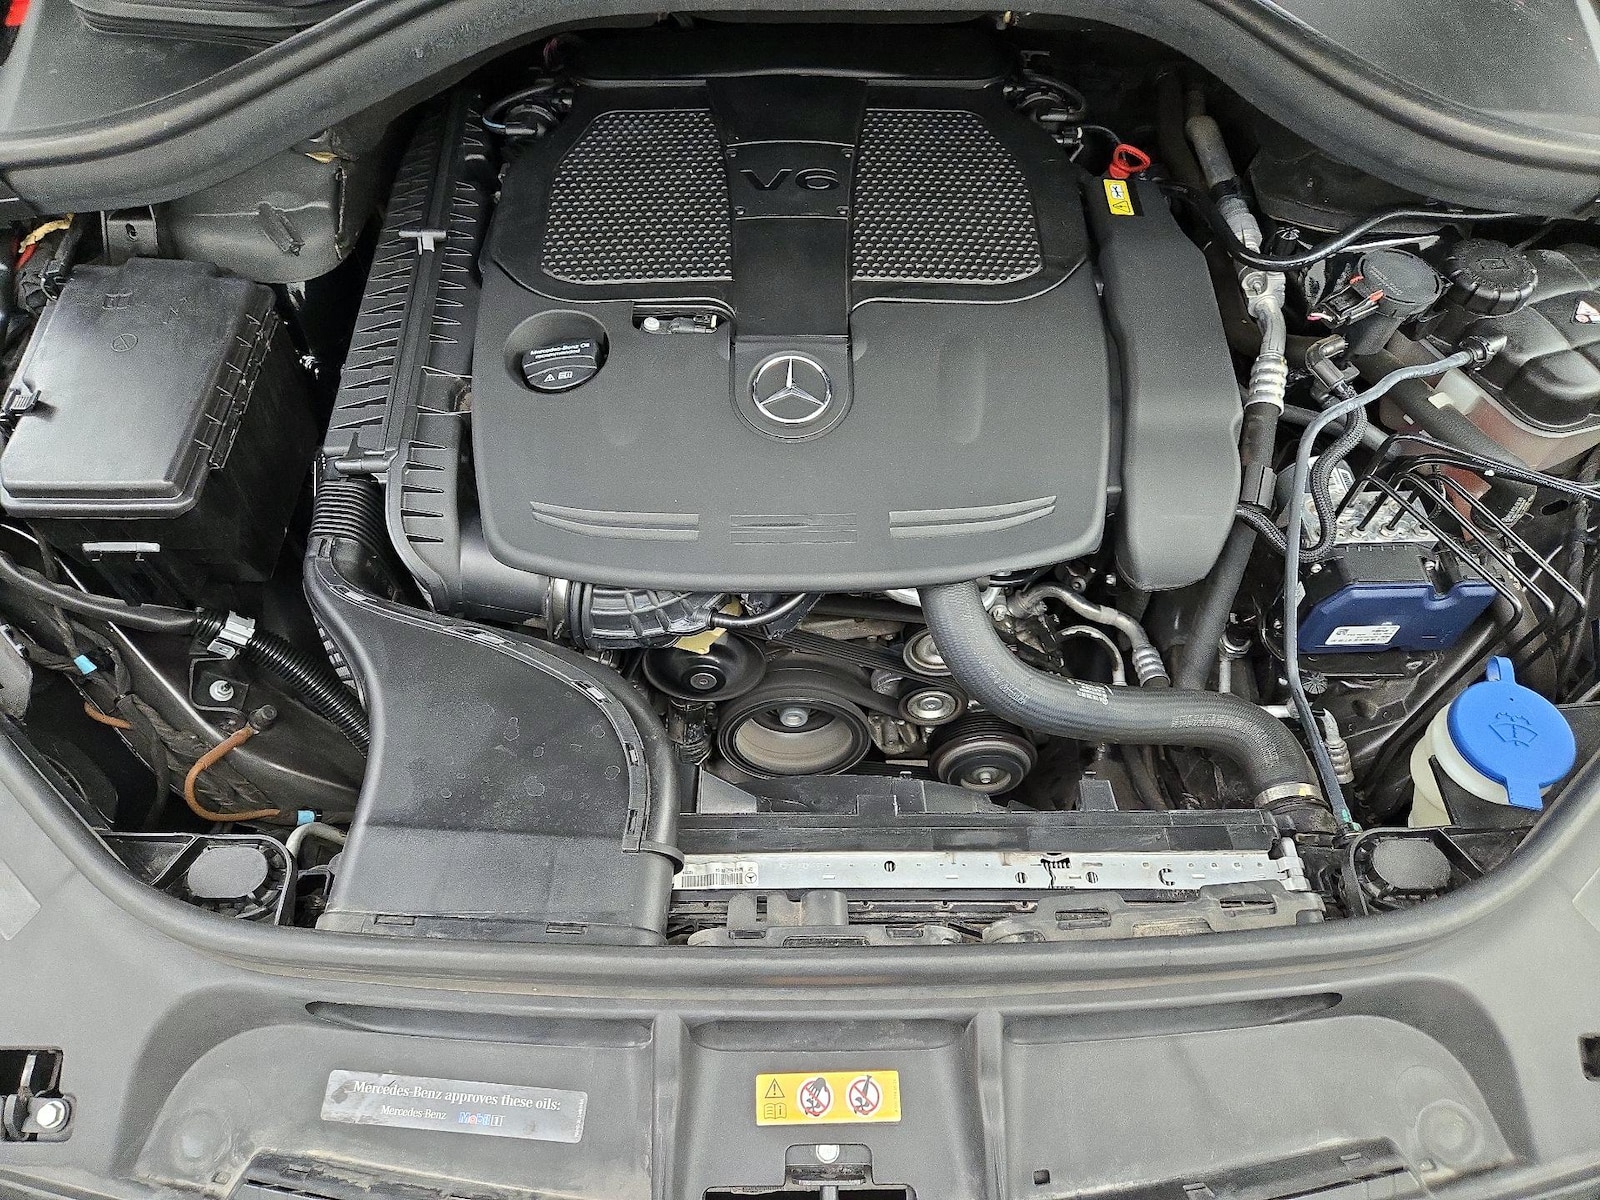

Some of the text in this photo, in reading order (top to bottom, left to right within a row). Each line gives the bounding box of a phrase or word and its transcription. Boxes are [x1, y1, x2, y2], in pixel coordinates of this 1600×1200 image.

[740, 168, 840, 190] V6
[530, 344, 579, 355] Mercedes-Benz
[535, 348, 581, 359] recommended
[353, 1080, 561, 1111] Mercedes-Benz approves these oils:
[458, 1111, 491, 1126] Mobil
